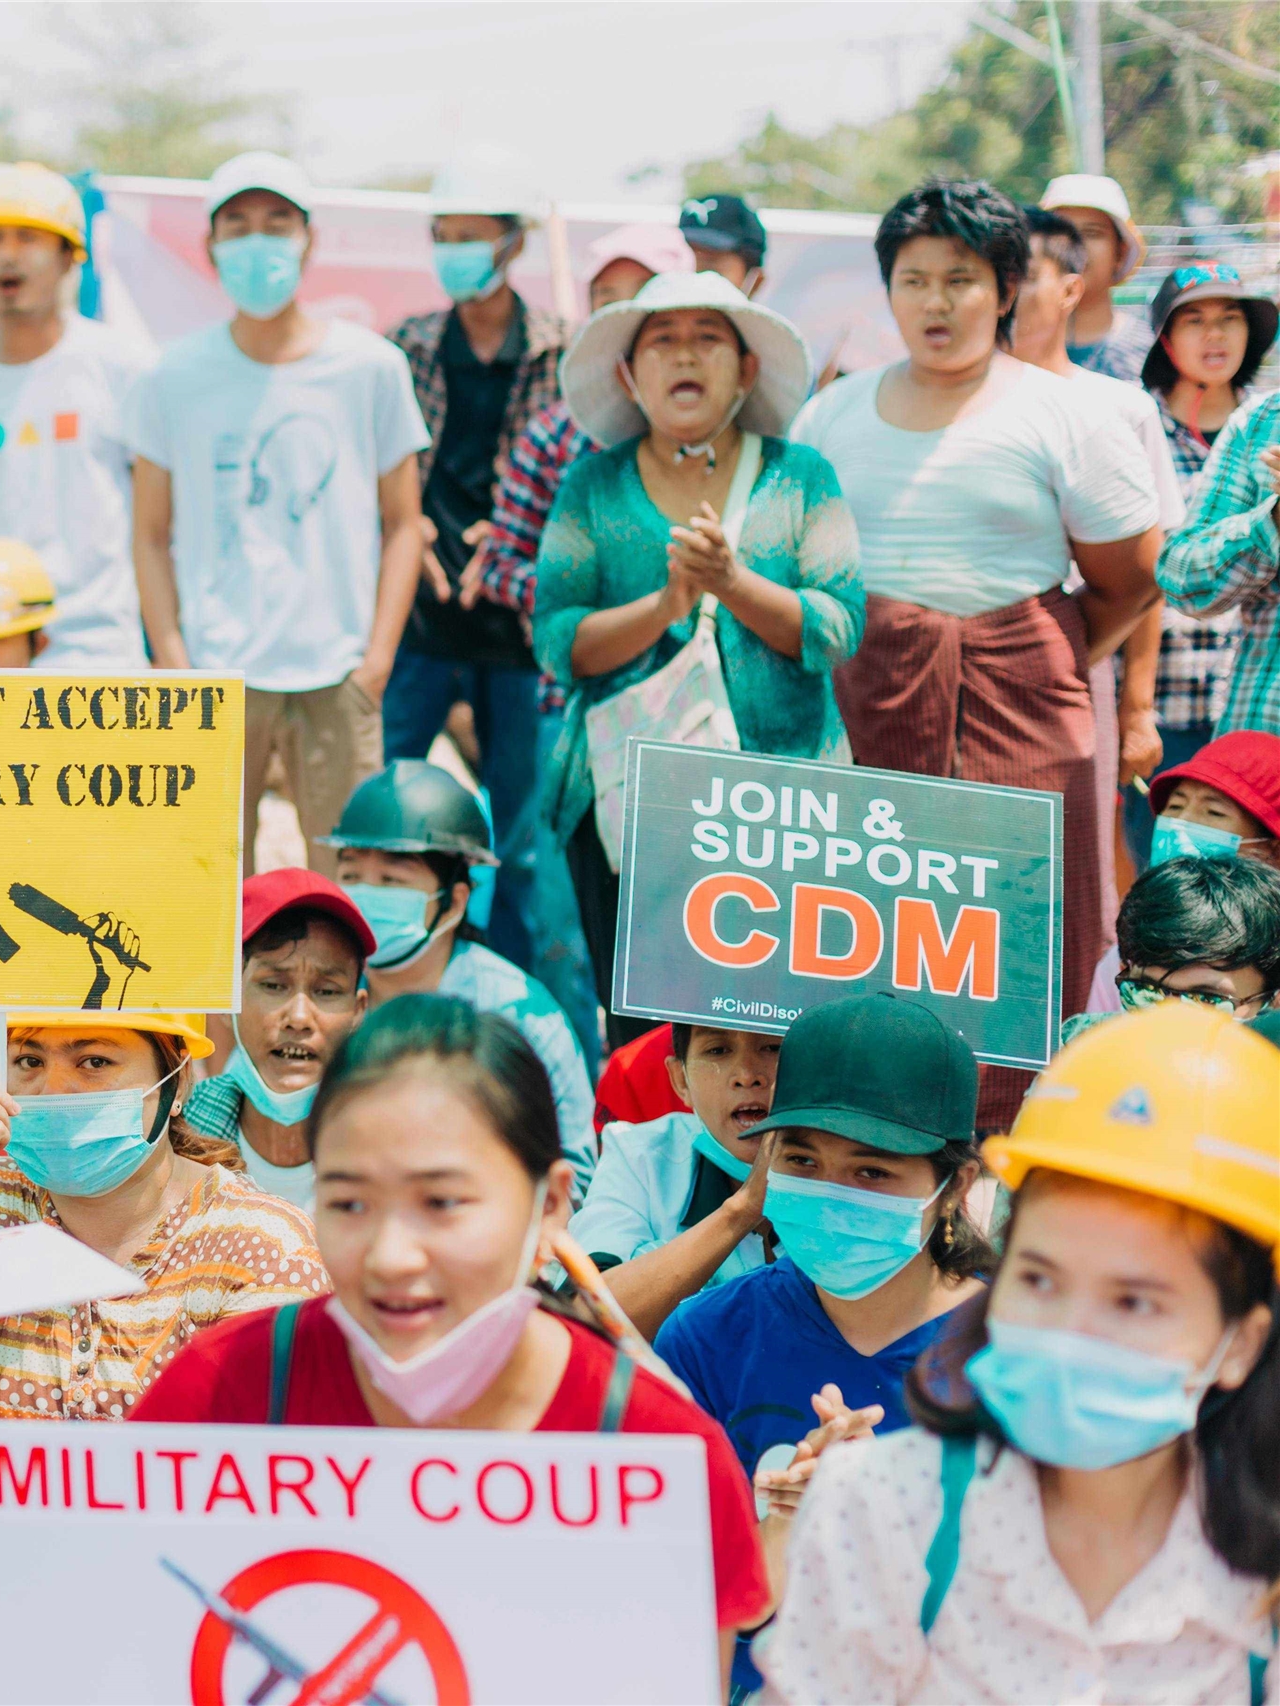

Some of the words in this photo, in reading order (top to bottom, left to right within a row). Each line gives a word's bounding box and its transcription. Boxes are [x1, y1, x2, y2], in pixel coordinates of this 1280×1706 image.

[20, 687, 224, 730] ACCEPT
[57, 764, 196, 807] COUP
[691, 777, 838, 832] JOIN
[862, 798, 905, 841] &
[690, 820, 999, 898] SUPPORT
[682, 872, 1000, 1002] CDM
[409, 1457, 667, 1529] COUP
